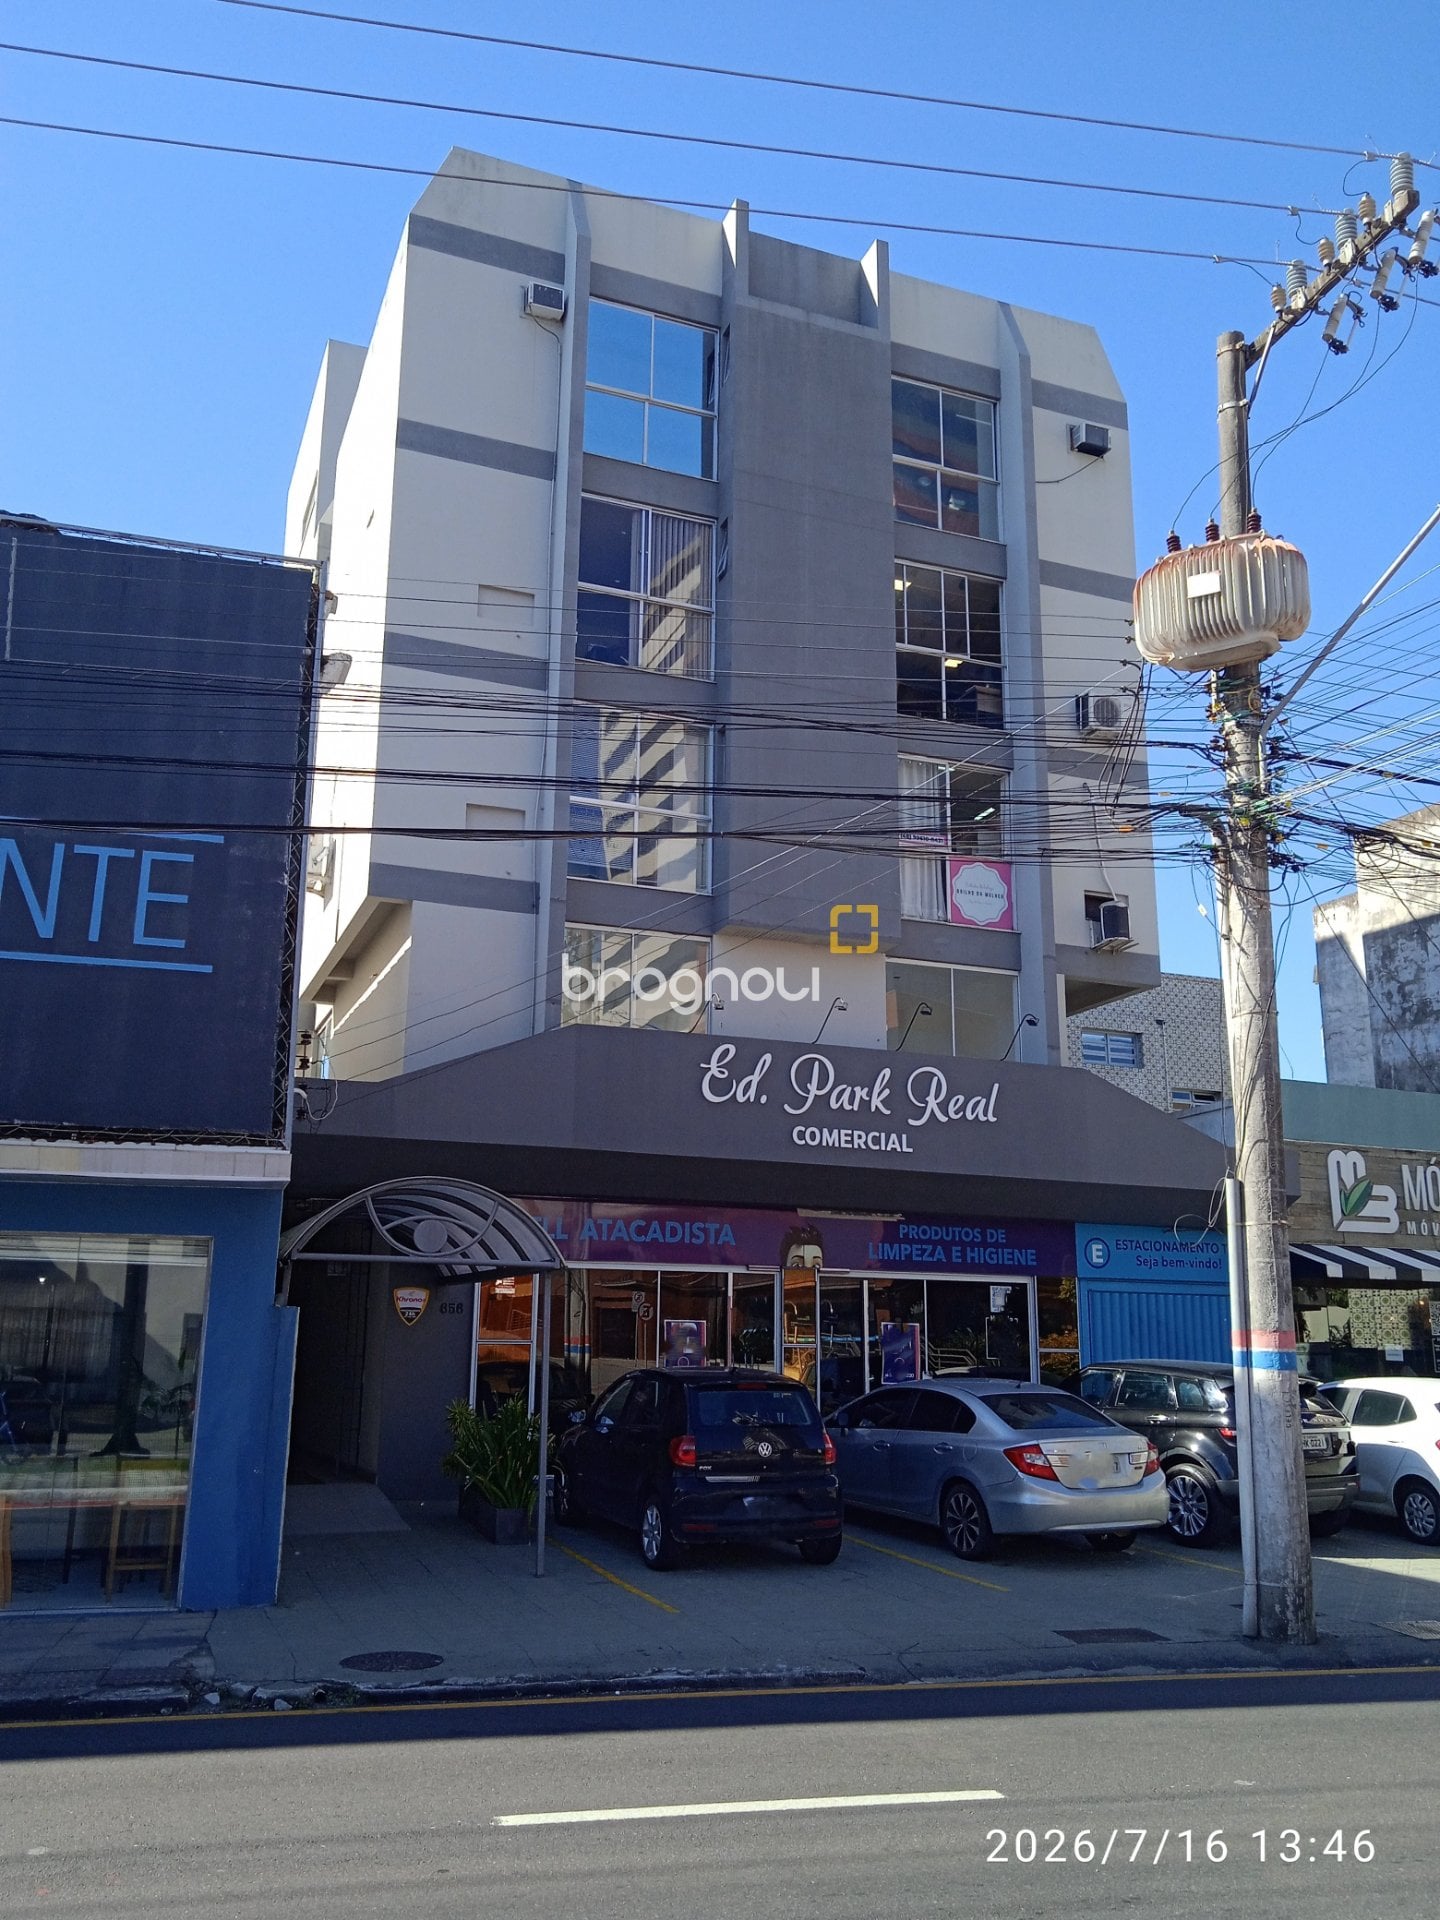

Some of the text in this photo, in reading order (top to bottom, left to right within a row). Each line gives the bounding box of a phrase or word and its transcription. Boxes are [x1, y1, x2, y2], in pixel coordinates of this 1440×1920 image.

[700, 1043, 999, 1126] Ed. Park Real
[792, 1125, 913, 1153] COMERCIAL
[580, 1217, 736, 1246] ATACADISTA
[899, 1224, 1007, 1243] PRODUTOS DE
[868, 1242, 1037, 1266] LIMPEZA E HIGIENE
[1115, 1239, 1219, 1255] ESTACIONAMENTO
[1136, 1255, 1222, 1270] Seja bem-vindo!
